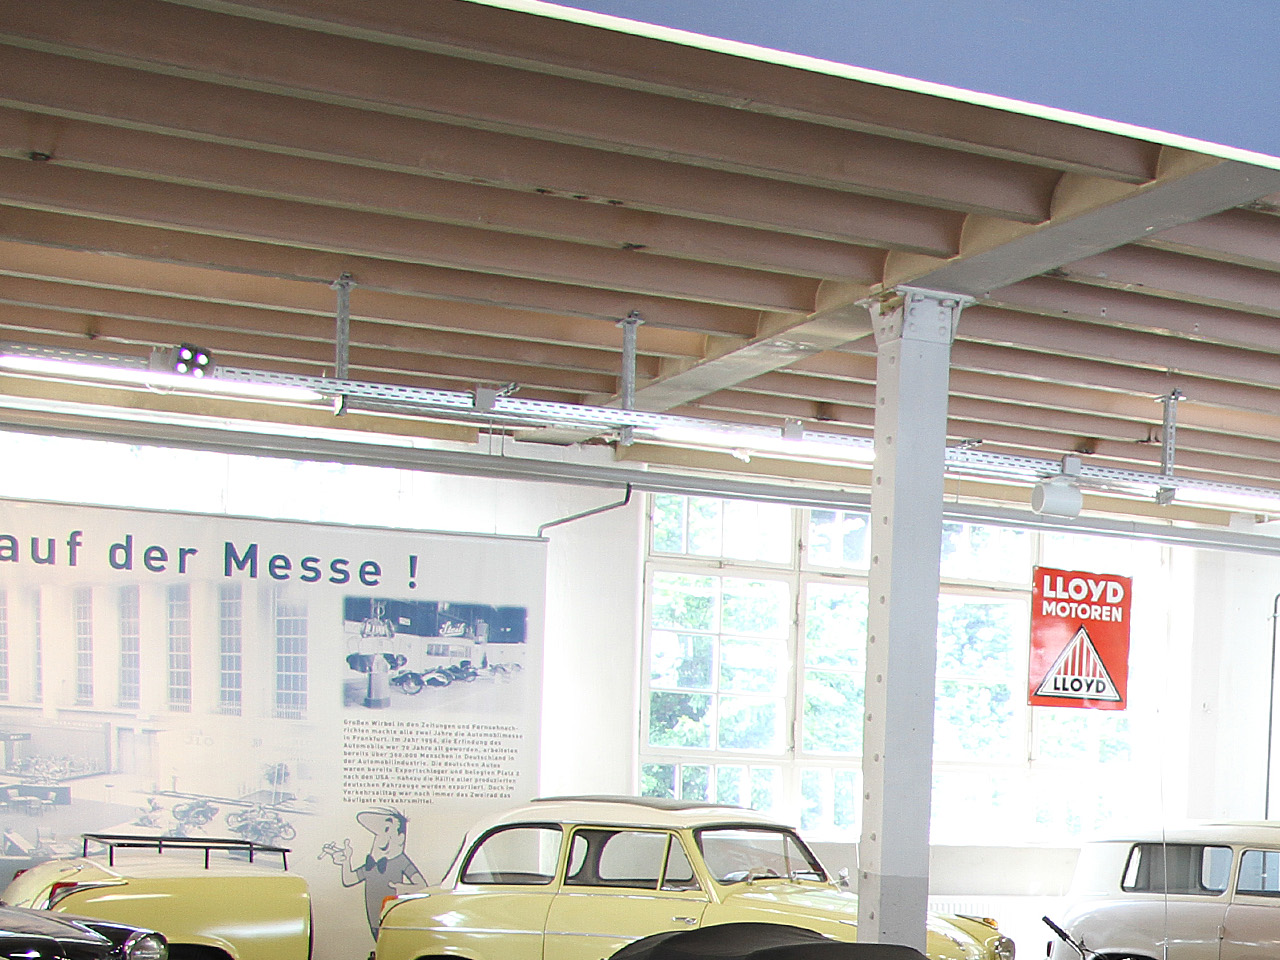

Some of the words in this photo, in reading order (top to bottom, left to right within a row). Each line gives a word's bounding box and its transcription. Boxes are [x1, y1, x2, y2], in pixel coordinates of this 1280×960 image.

[0, 530, 84, 567] auf
[108, 534, 199, 574] der
[223, 541, 383, 587] Messe
[407, 554, 419, 589] !
[1043, 575, 1125, 603] LLOYD
[1042, 601, 1123, 623] MOTOREN
[1053, 676, 1106, 693] LLOYD
[421, 722, 456, 730] Zeitungen
[454, 738, 488, 746] Erfindung
